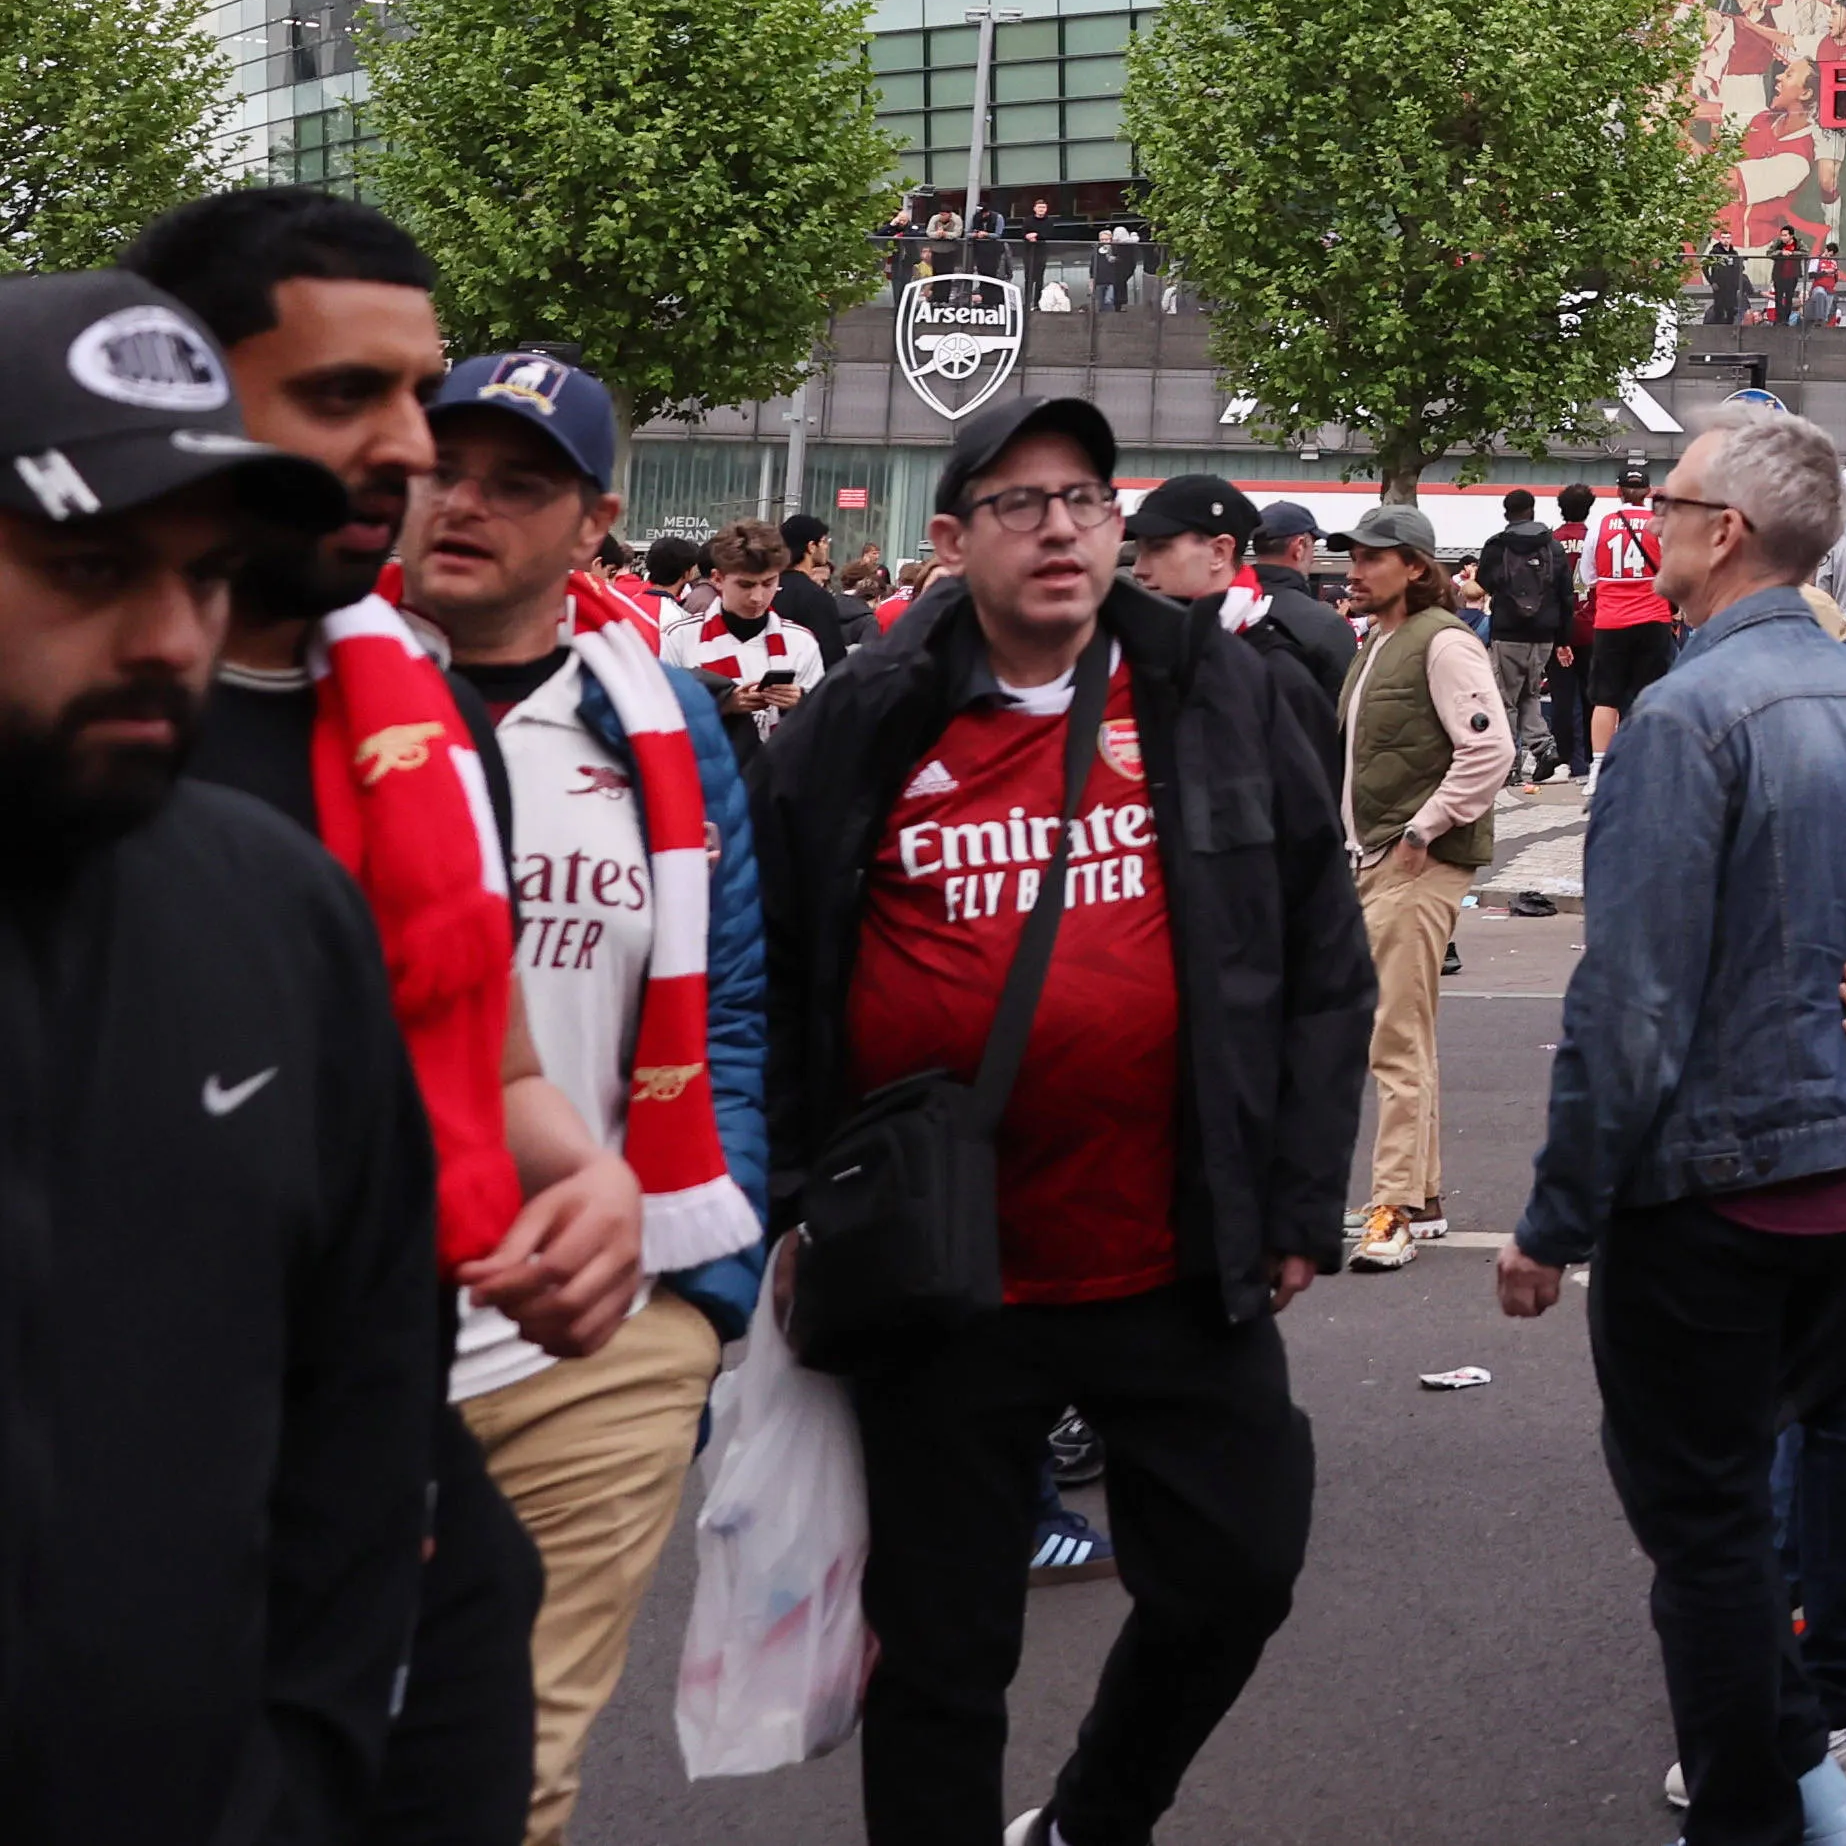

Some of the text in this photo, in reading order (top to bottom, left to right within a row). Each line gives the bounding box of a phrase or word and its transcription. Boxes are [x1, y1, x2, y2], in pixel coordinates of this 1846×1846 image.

[915, 301, 1007, 327] Arsenal
[664, 516, 710, 529] MEDIA
[1607, 532, 1645, 578] 14
[900, 801, 1158, 880] Emirate
[512, 846, 646, 911] ates
[945, 854, 1146, 923] FLY BTTER
